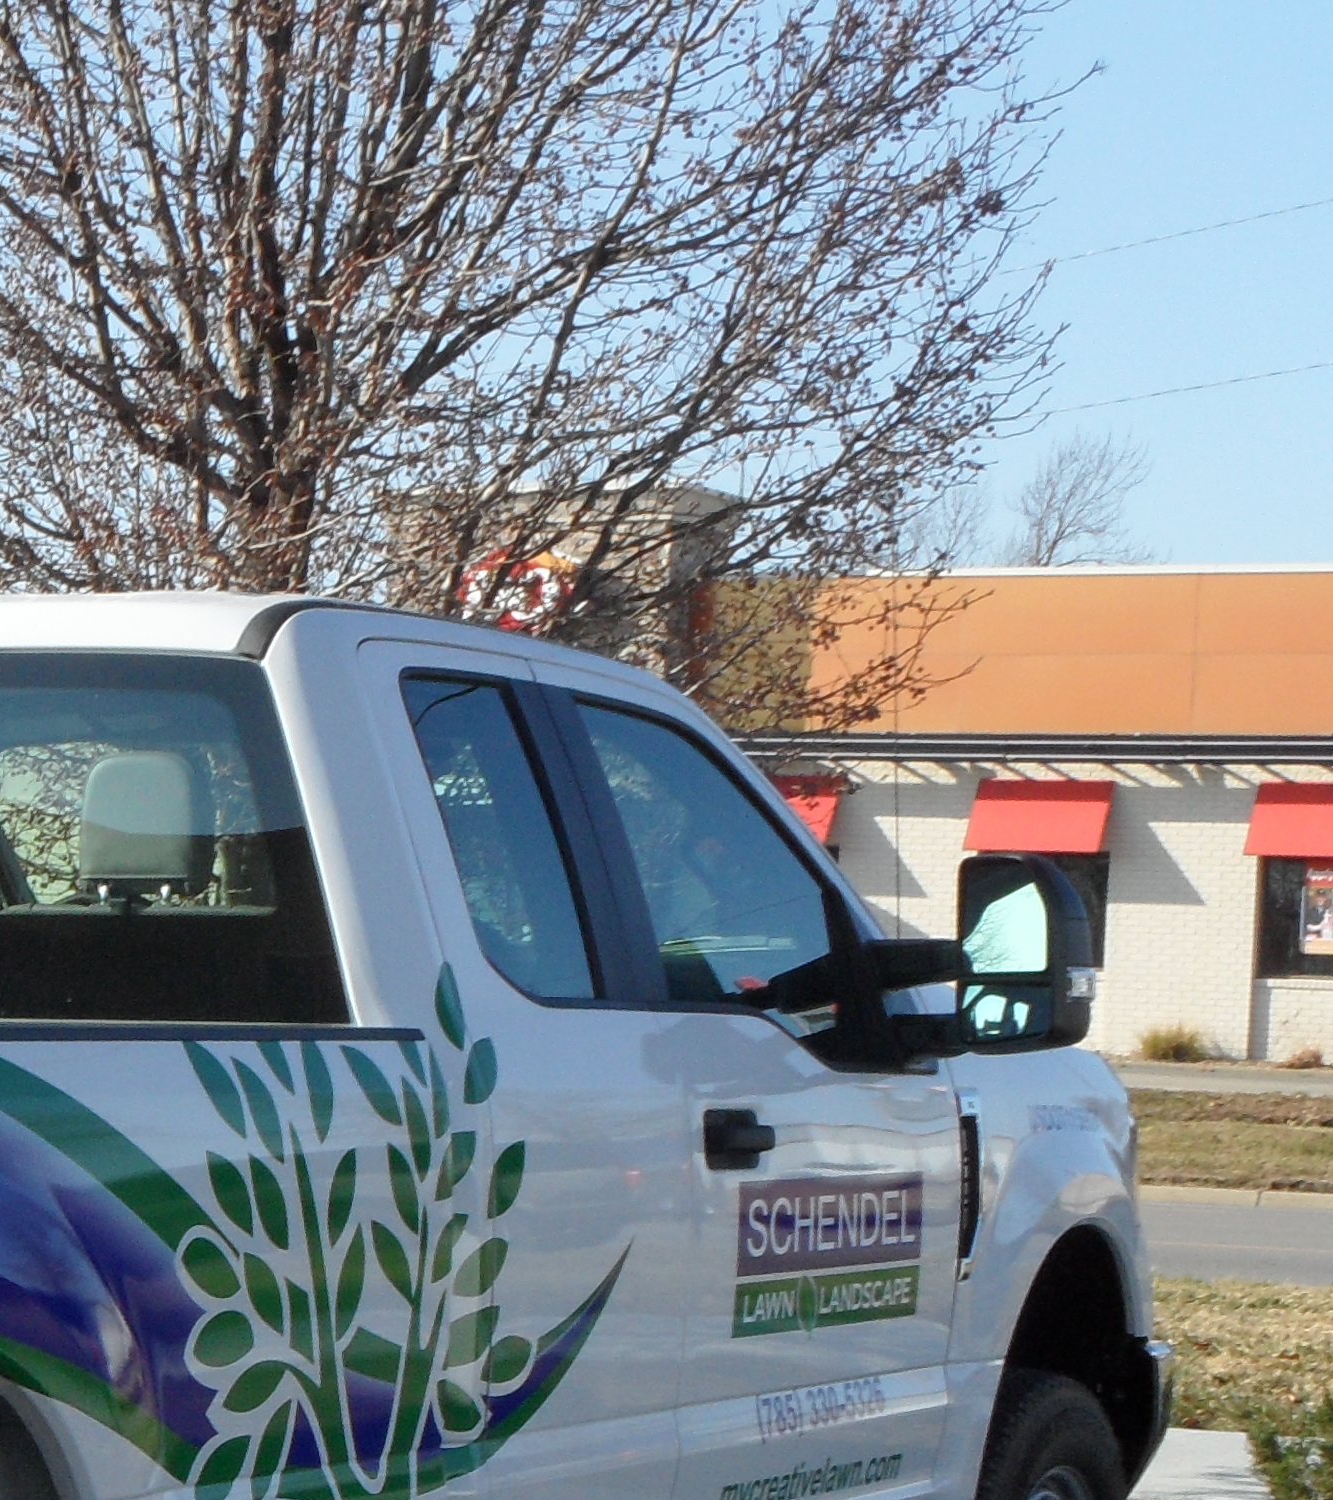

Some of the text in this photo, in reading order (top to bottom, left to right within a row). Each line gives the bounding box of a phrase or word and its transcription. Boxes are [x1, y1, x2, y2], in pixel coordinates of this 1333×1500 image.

[746, 1189, 916, 1258] SCHENDEL
[742, 1276, 912, 1324] LAWN LANDSCAPE
[756, 1390, 804, 1445] (785)
